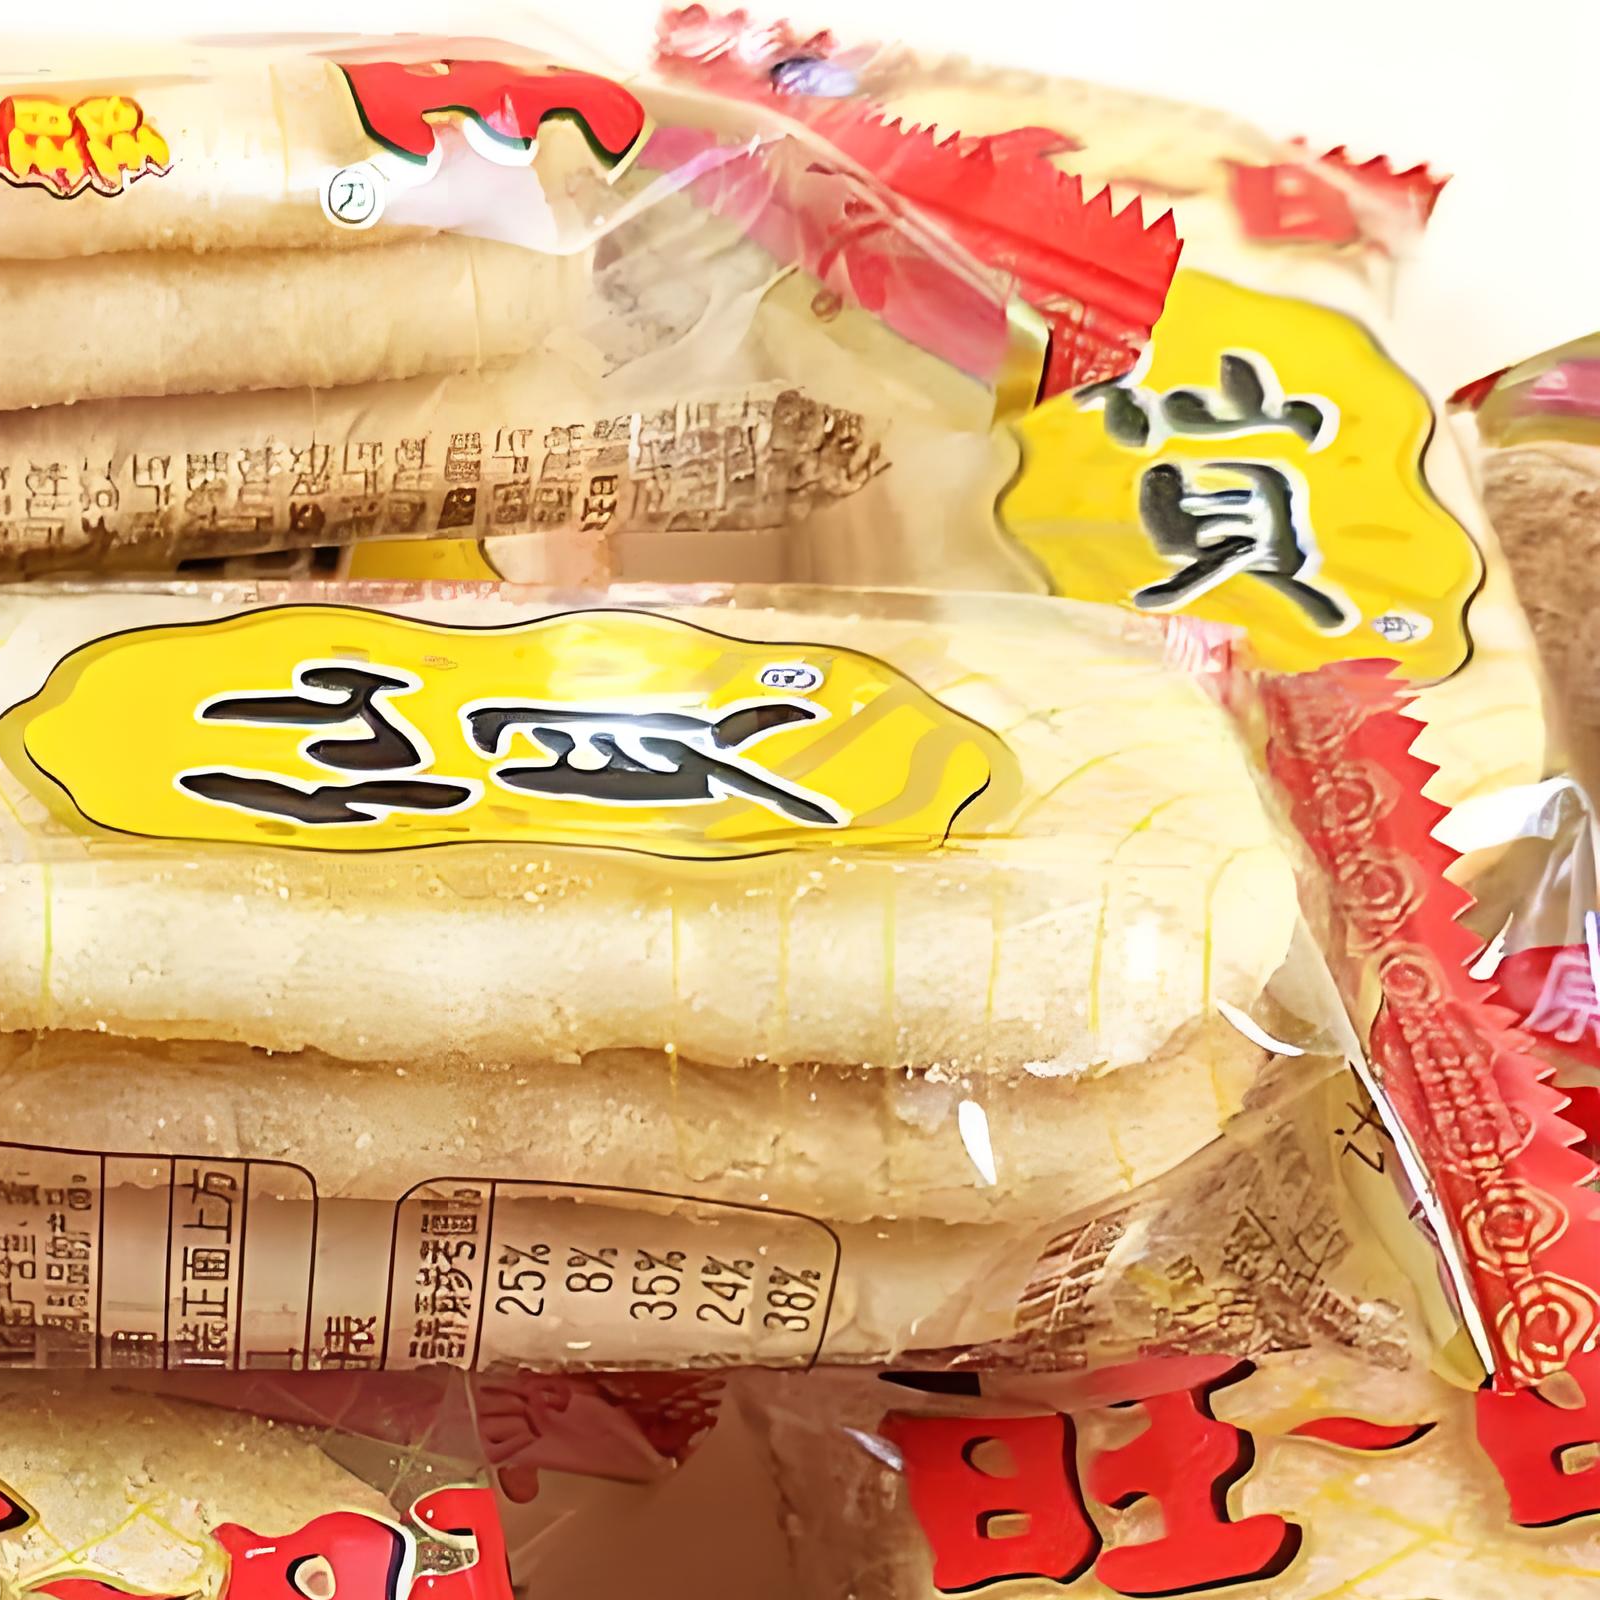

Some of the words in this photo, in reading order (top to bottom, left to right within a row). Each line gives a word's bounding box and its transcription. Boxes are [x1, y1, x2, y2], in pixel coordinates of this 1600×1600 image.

[494, 1242, 551, 1317] 25%
[565, 1246, 618, 1293] 8%
[629, 1248, 686, 1322] 35%
[696, 1255, 755, 1326] 24%
[762, 1265, 821, 1332] 38%
